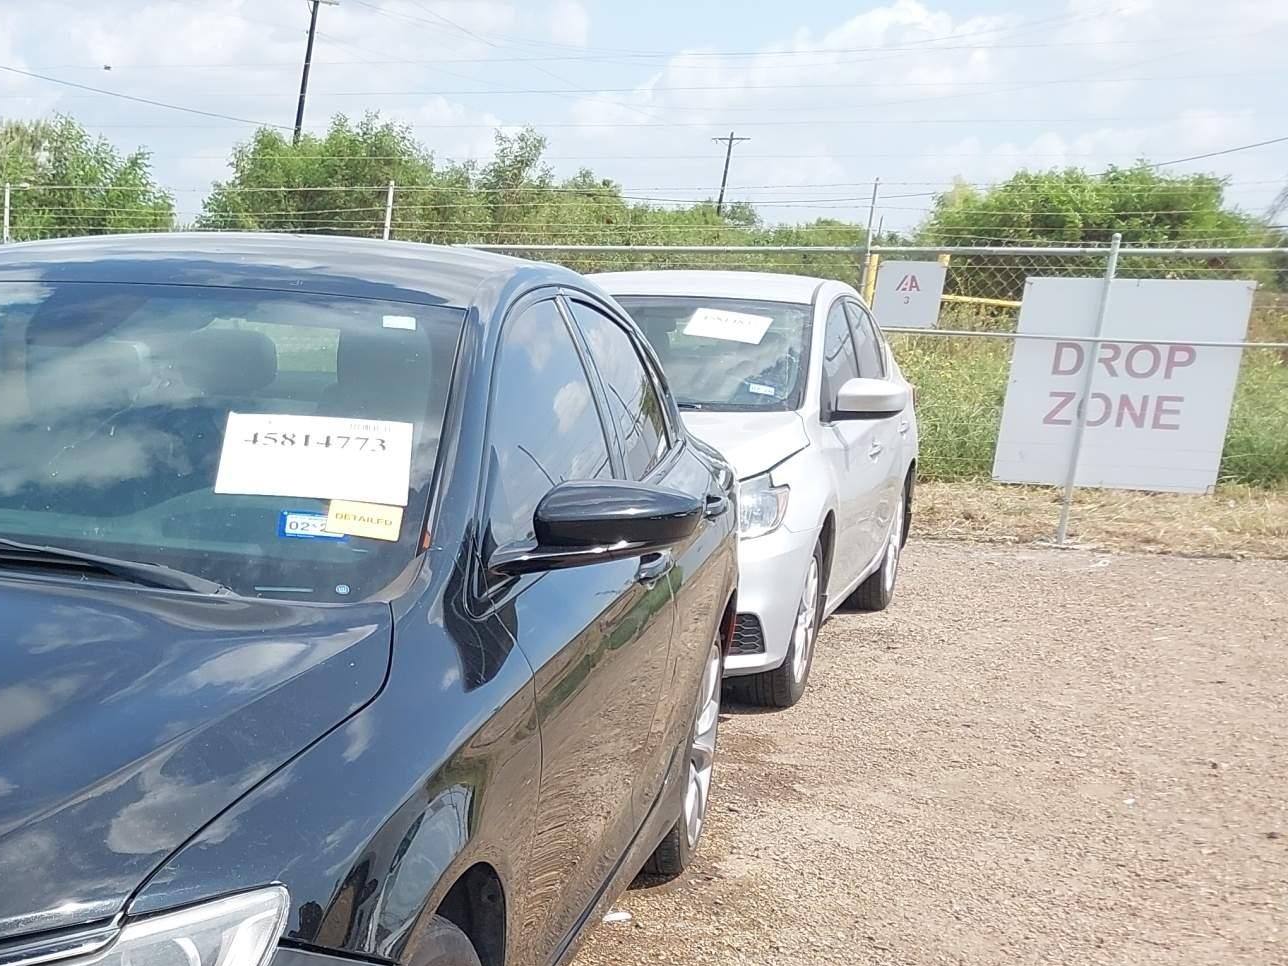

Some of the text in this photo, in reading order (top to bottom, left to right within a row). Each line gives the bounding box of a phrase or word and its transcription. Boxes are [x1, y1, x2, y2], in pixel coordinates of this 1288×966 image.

[1051, 342, 1197, 380] DROP
[1043, 391, 1185, 430] ZONE
[244, 432, 388, 453] 45814773
[335, 512, 393, 526] DETAILED
